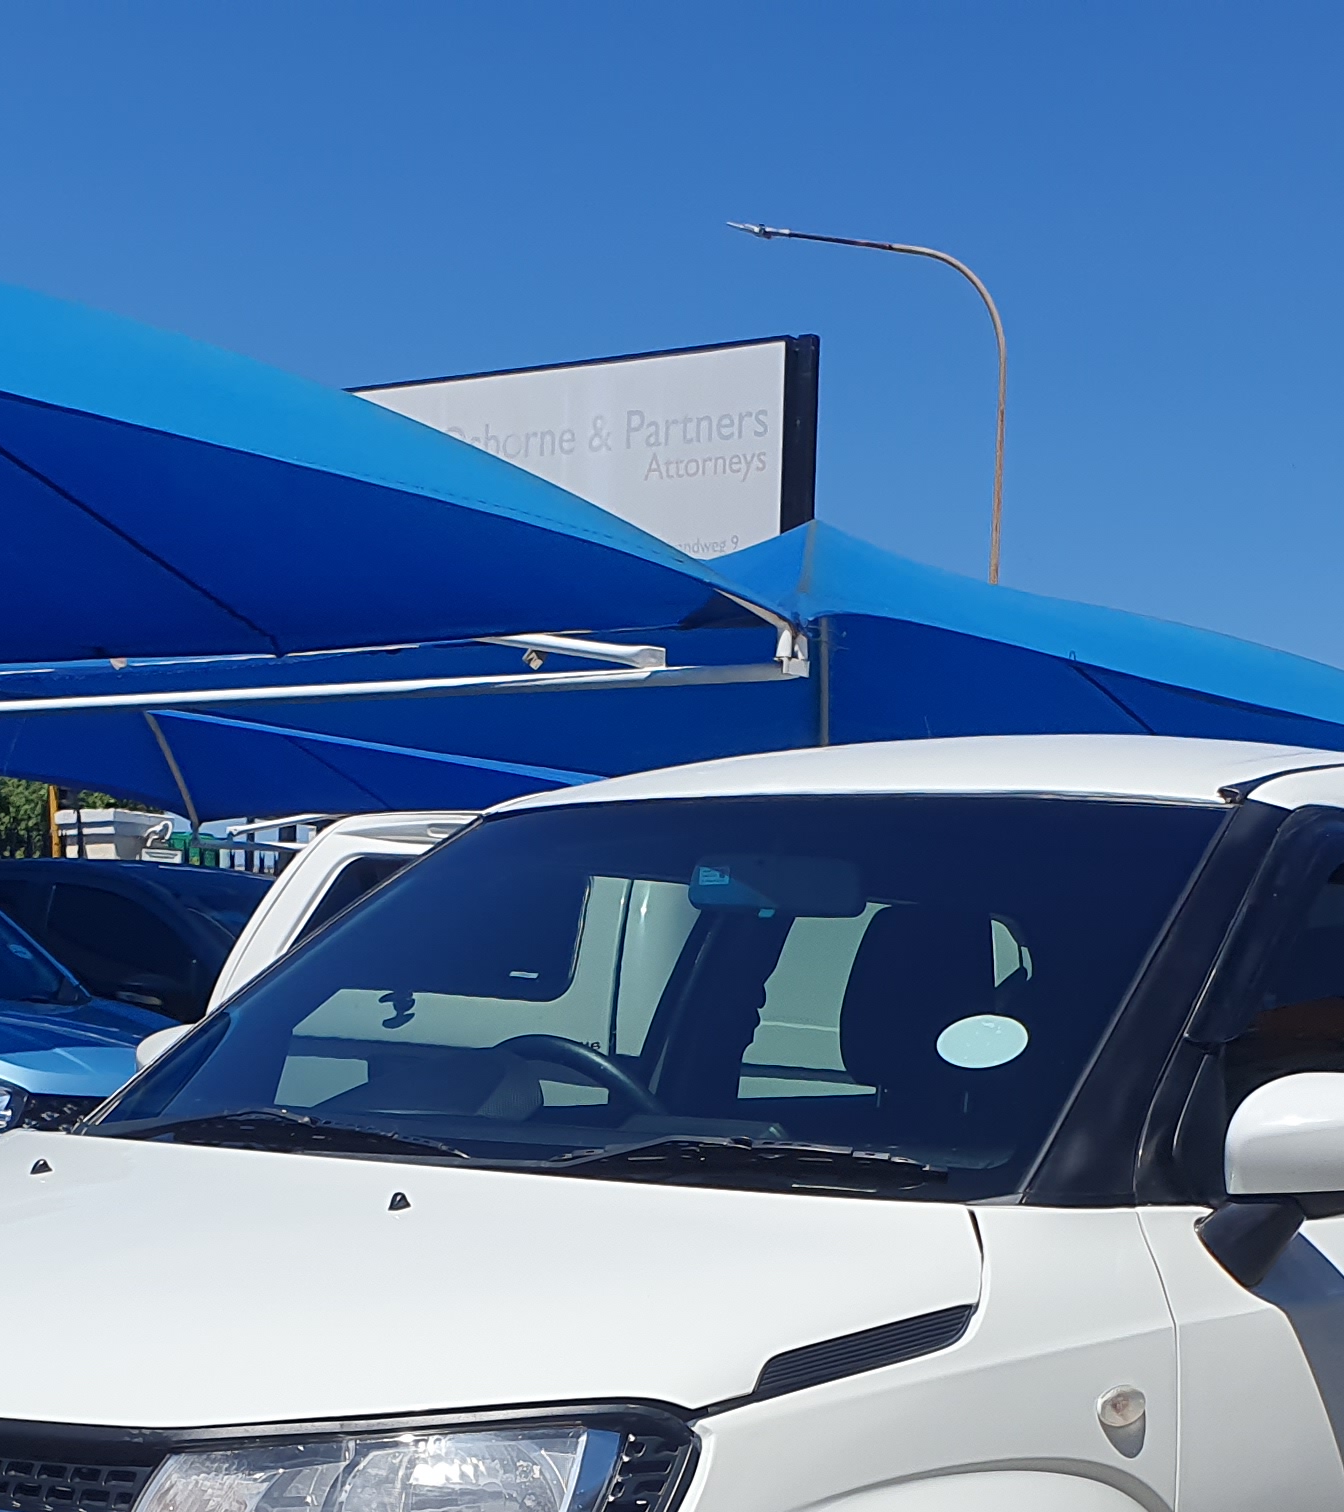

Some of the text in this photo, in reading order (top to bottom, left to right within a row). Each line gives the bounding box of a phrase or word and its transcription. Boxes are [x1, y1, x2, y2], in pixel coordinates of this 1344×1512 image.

[588, 414, 612, 453] &
[625, 408, 769, 450] Partners
[644, 450, 767, 483] Attorneys
